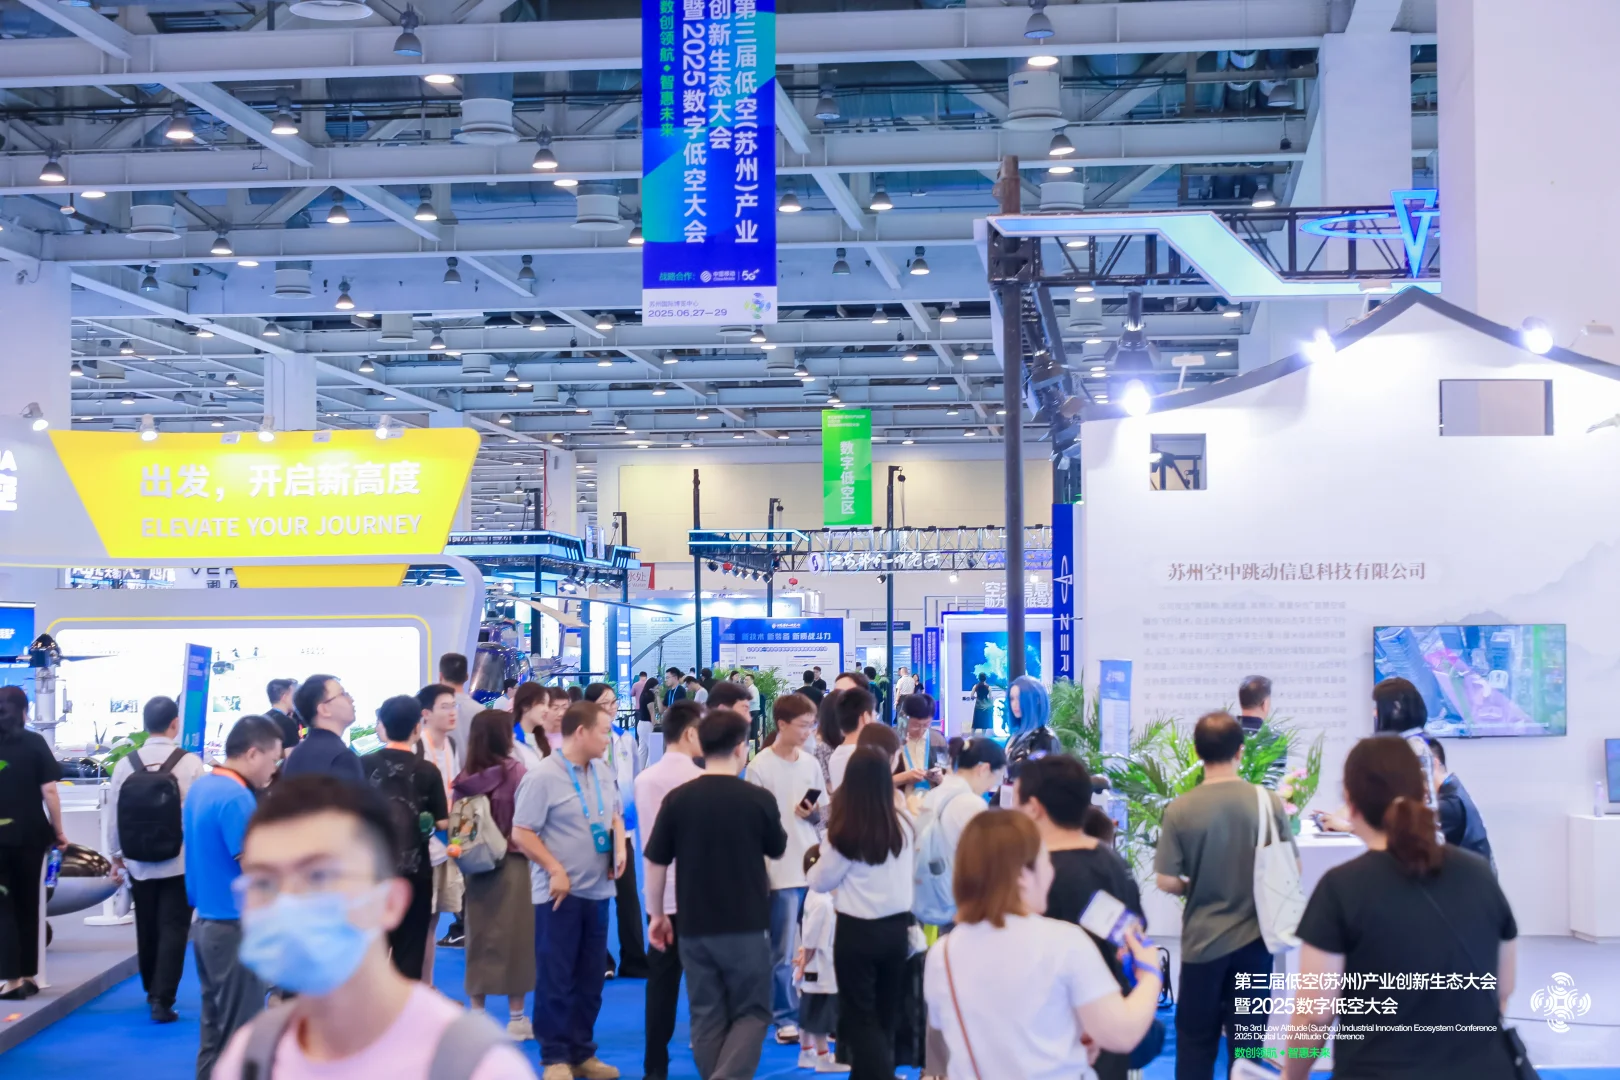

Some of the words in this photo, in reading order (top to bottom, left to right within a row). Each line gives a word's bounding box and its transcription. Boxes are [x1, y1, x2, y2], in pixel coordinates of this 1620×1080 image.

[708, 0, 733, 150] 创新生态大会
[682, 0, 707, 244] 暨2025数字低空大会
[733, 0, 759, 244] 第三届低空(苏州)产业
[741, 269, 758, 281] 5G
[839, 441, 856, 515] 数字低空区
[141, 517, 241, 539] ELEVATE
[247, 515, 309, 537] YOUR
[315, 514, 422, 536] JOURNEY
[1167, 561, 1426, 582] 苏州空中跳动信息科技有限公司
